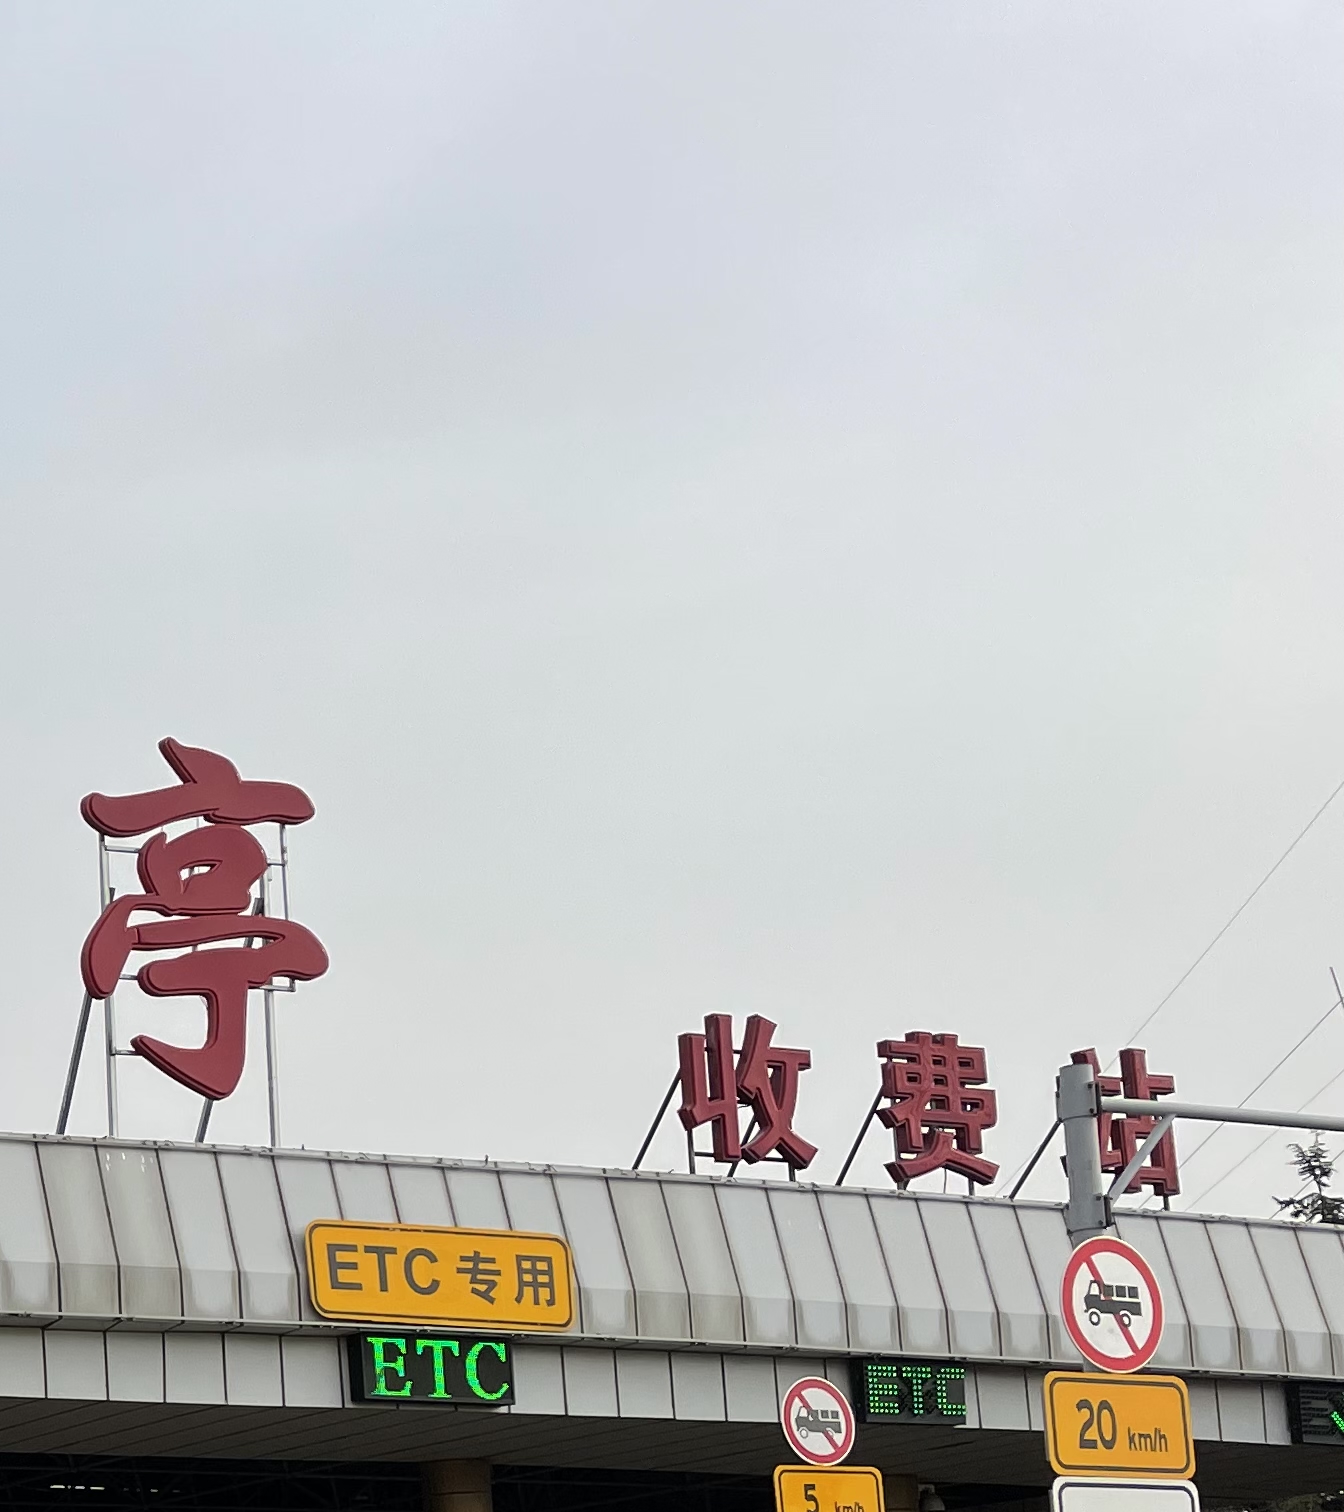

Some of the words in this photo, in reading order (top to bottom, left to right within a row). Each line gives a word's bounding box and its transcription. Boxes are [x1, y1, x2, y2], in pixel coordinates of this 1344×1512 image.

[81, 736, 329, 1100] 亭
[367, 1336, 510, 1401] ETC
[867, 1364, 967, 1416] ETC
[1076, 1398, 1117, 1450] 20
[1127, 1427, 1169, 1453] km/h
